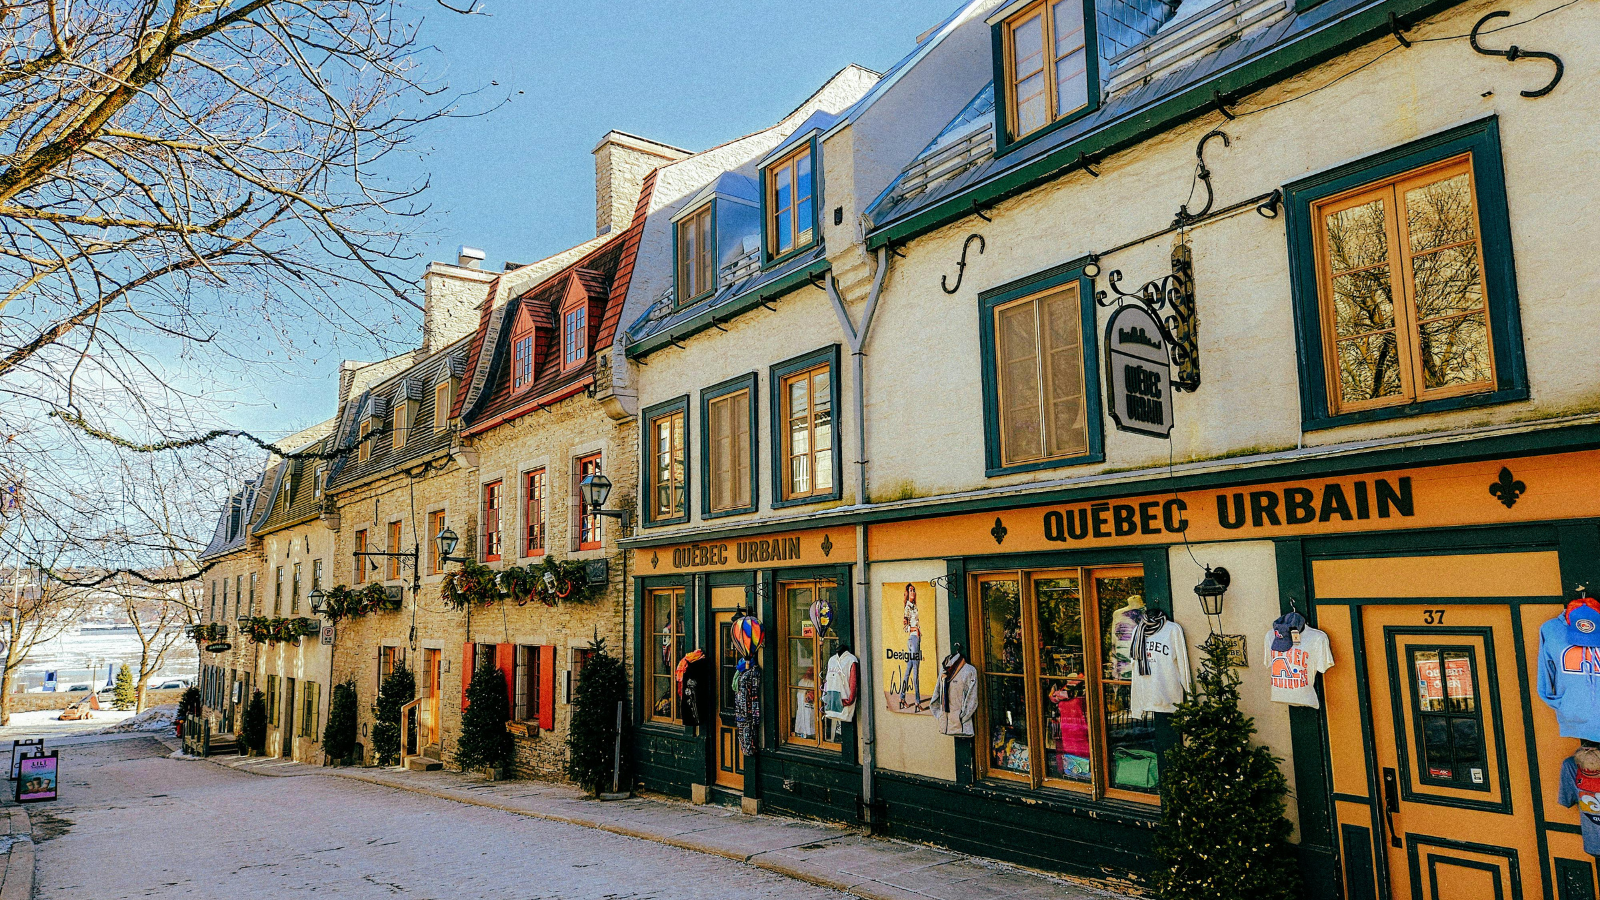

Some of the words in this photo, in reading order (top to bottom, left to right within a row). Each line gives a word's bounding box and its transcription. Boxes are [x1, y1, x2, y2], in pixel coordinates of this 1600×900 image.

[1126, 394, 1164, 425] URBAIN
[1216, 477, 1415, 529] URBAIN
[736, 537, 801, 564] URBAIN
[1423, 609, 1446, 625] 37
[1425, 668, 1464, 678] OUERT
[1433, 679, 1462, 689] OEN
